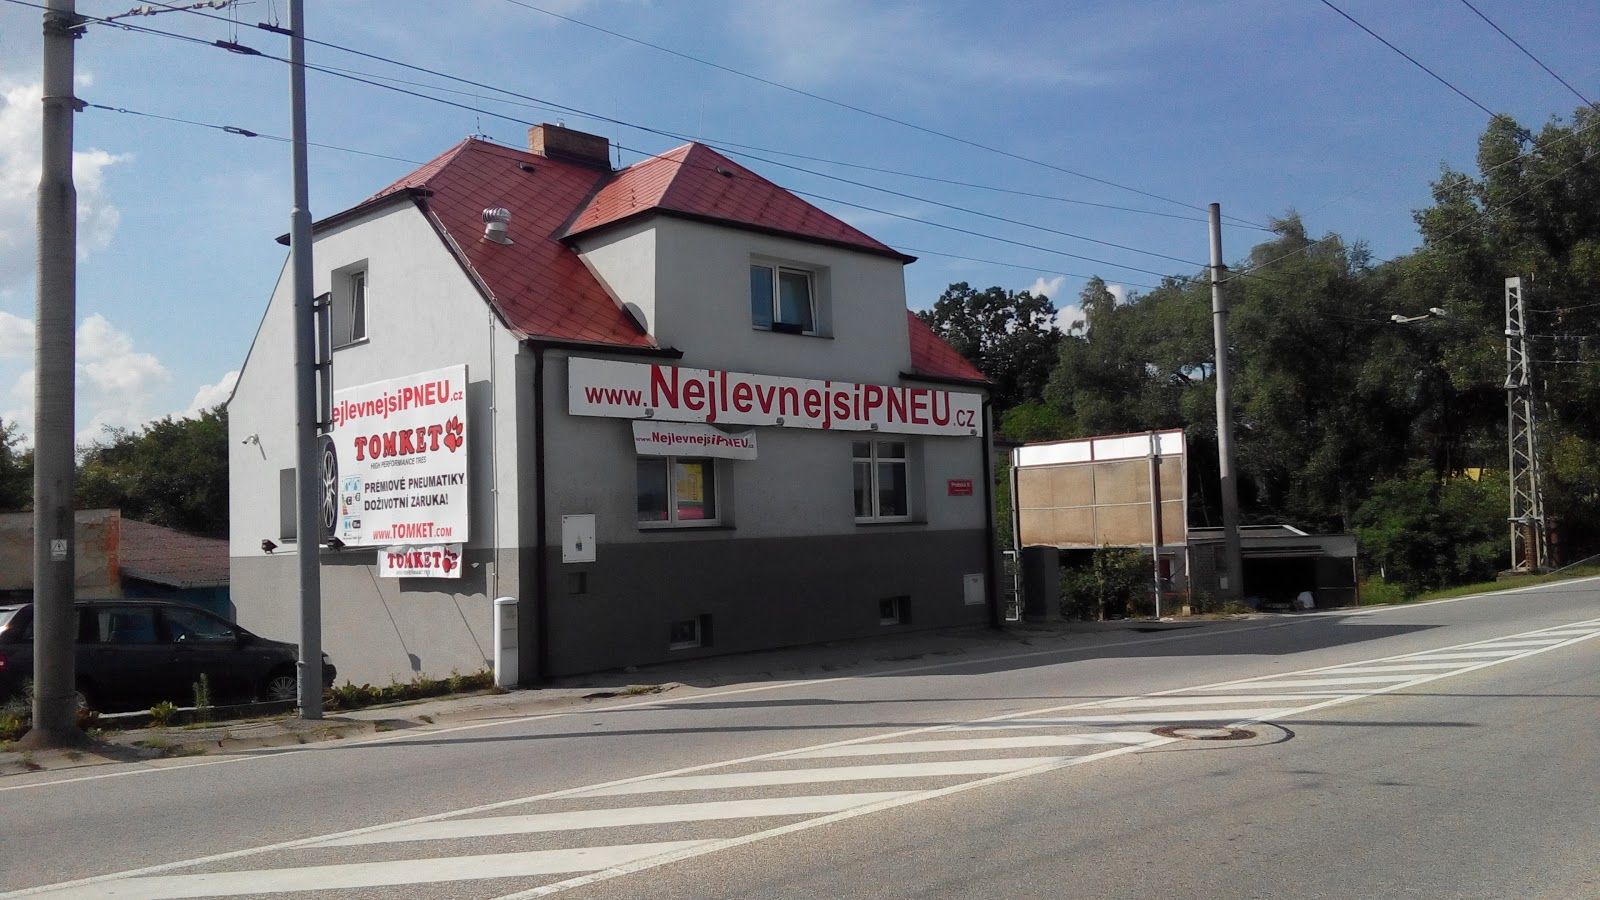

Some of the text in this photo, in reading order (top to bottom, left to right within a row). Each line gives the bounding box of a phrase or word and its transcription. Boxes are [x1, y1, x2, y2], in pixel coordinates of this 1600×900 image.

[332, 380, 463, 427] ejlevnejsiPNEU.cz
[585, 362, 976, 430] www.NejlevnejsiPNEU.cz
[354, 423, 443, 461] TOMKET
[408, 472, 465, 489] PNEUMATIKY
[364, 494, 409, 511] DOŽIVOTNÍ
[387, 551, 442, 569] TOMKET
